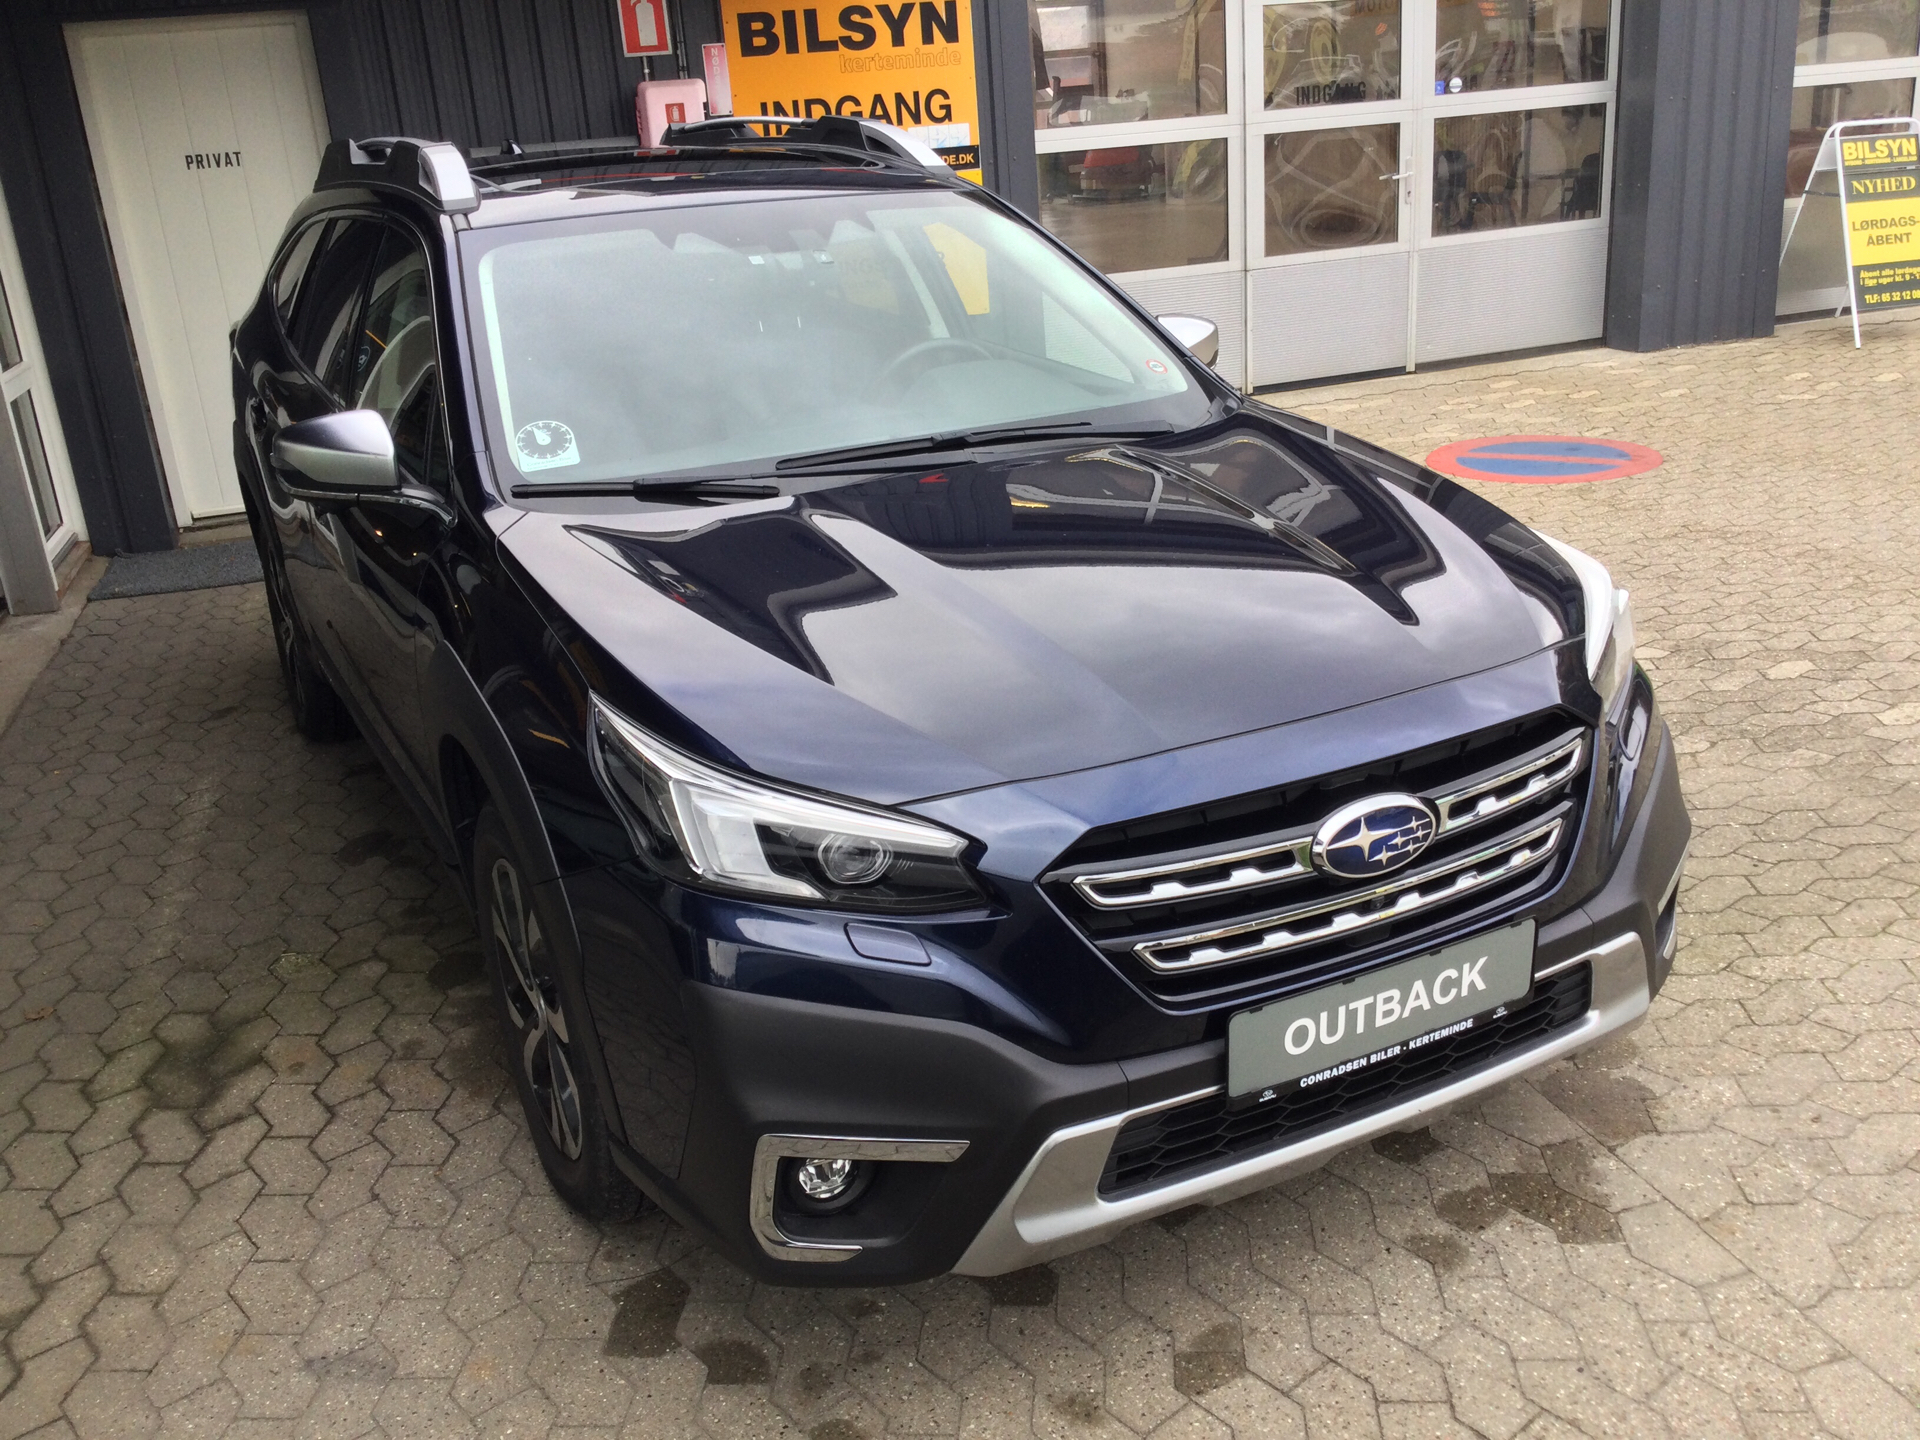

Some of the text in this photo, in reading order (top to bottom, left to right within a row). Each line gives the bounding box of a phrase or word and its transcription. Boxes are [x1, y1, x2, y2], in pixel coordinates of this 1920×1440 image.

[737, 0, 960, 57] BILSYN
[839, 48, 962, 73] kerteminde
[1296, 80, 1366, 106] INDGANG
[941, 153, 975, 165] DE.DK
[1842, 137, 1917, 160] BILSYN
[185, 152, 241, 170] PRIVAT
[1851, 176, 1916, 195] NYHED
[1852, 215, 1920, 231] LØRDAGS-
[1866, 232, 1912, 247] ÅBENT
[1864, 293, 1881, 304] TLF:
[1891, 291, 1901, 301] 32
[1902, 290, 1911, 300] 12
[1284, 956, 1488, 1055] OUTBACK
[1300, 1056, 1367, 1088] CONRADSEN
[1370, 1046, 1401, 1063] BILER
[1409, 1018, 1474, 1050] KERTEMINDE
